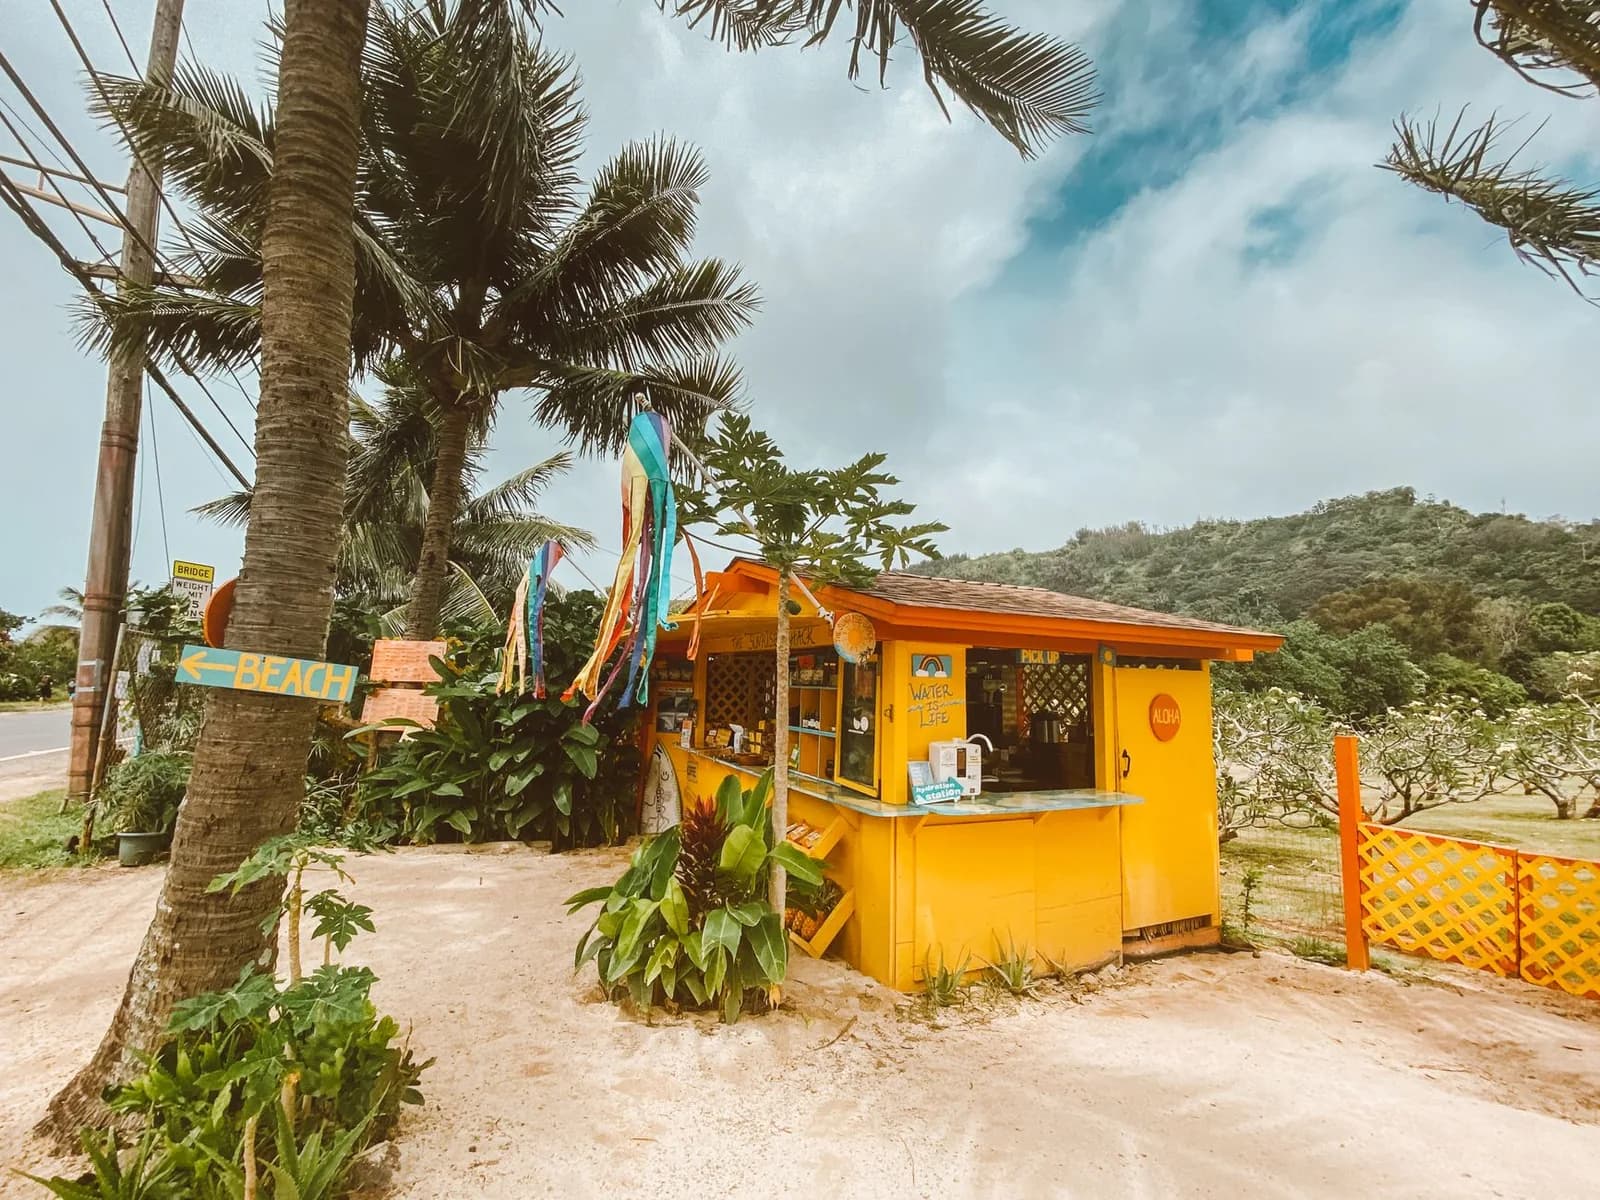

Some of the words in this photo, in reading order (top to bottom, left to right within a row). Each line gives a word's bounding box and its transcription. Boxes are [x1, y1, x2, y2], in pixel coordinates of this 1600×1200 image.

[177, 565, 210, 578] BRIDGE
[175, 580, 209, 592] WEIGHT
[789, 625, 815, 647] HACK
[1022, 649, 1043, 664] PICK
[1047, 650, 1060, 664] UP
[234, 653, 351, 701] BEACH
[908, 682, 953, 700] WATER
[927, 700, 939, 711] IS
[920, 711, 950, 728] LIFE
[1152, 708, 1180, 724] ALOHA
[916, 782, 955, 794] hydration
[926, 788, 961, 801] station
